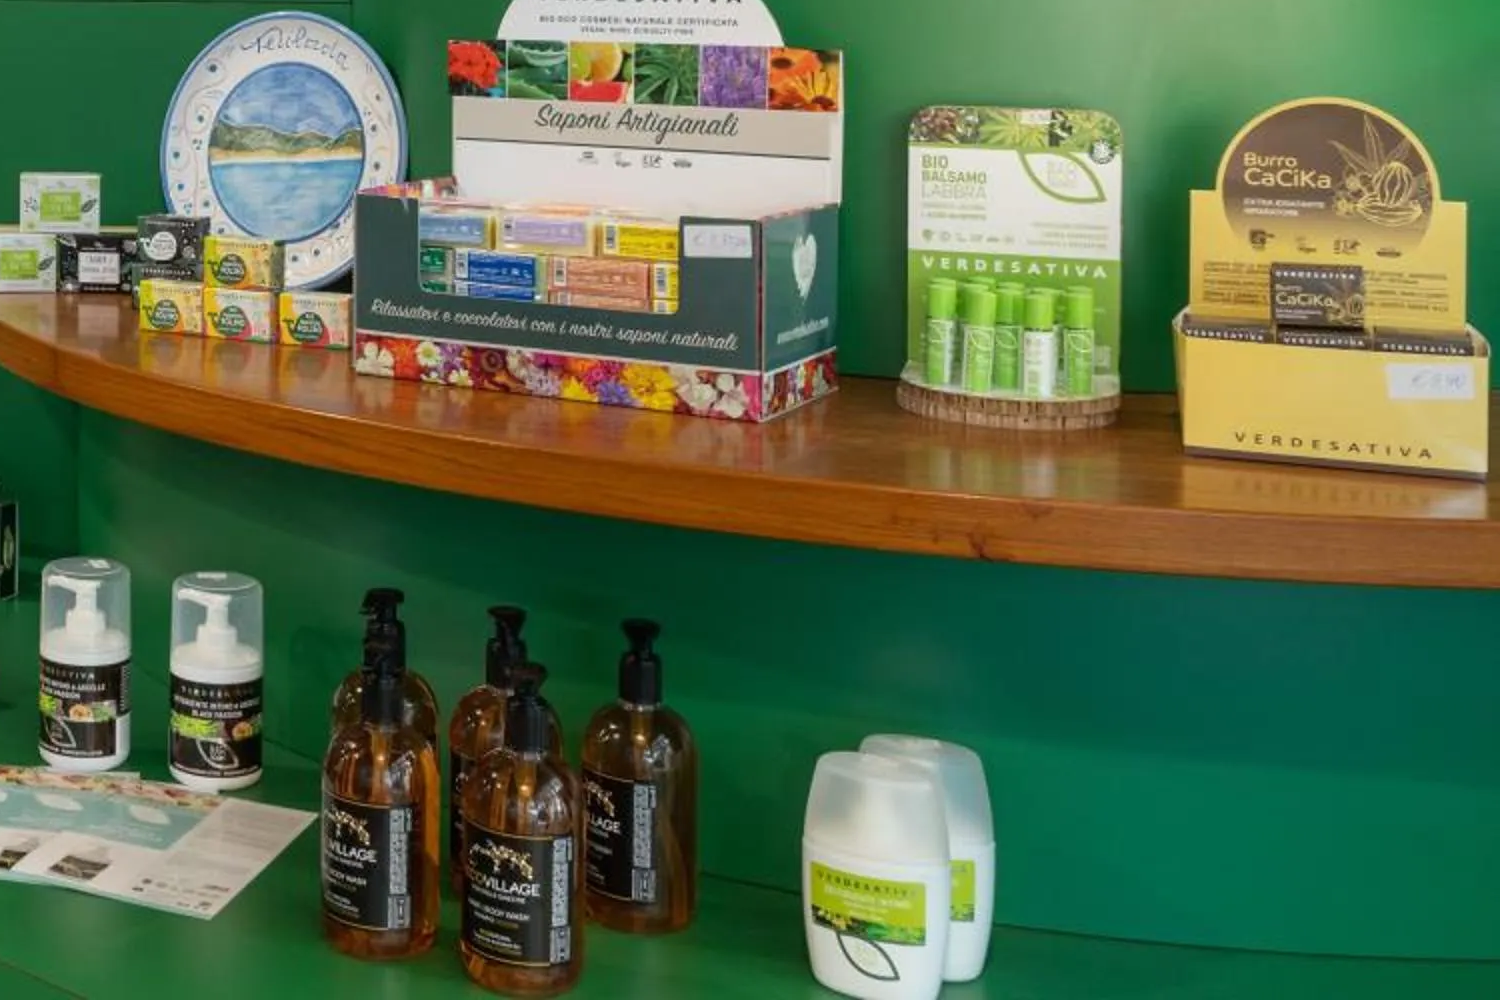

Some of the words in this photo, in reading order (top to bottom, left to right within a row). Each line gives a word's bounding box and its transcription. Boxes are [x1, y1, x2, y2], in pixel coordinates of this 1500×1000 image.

[535, 104, 610, 134] Saponi
[616, 108, 738, 144] Artigianali
[922, 155, 948, 168] BIO
[1244, 152, 1297, 168] Burro
[922, 171, 987, 183] BALSAMO
[1244, 169, 1332, 189] CaCiKa
[922, 184, 987, 199] LABBRA
[921, 256, 1107, 279] VERDESATIVA
[371, 299, 439, 322] Rilassatevi
[443, 313, 452, 322] e
[454, 309, 527, 331] coccolatevi
[530, 320, 555, 334] con
[569, 322, 612, 340] nostri
[615, 326, 667, 346] saponi
[1235, 432, 1432, 459] VERDESATIVA
